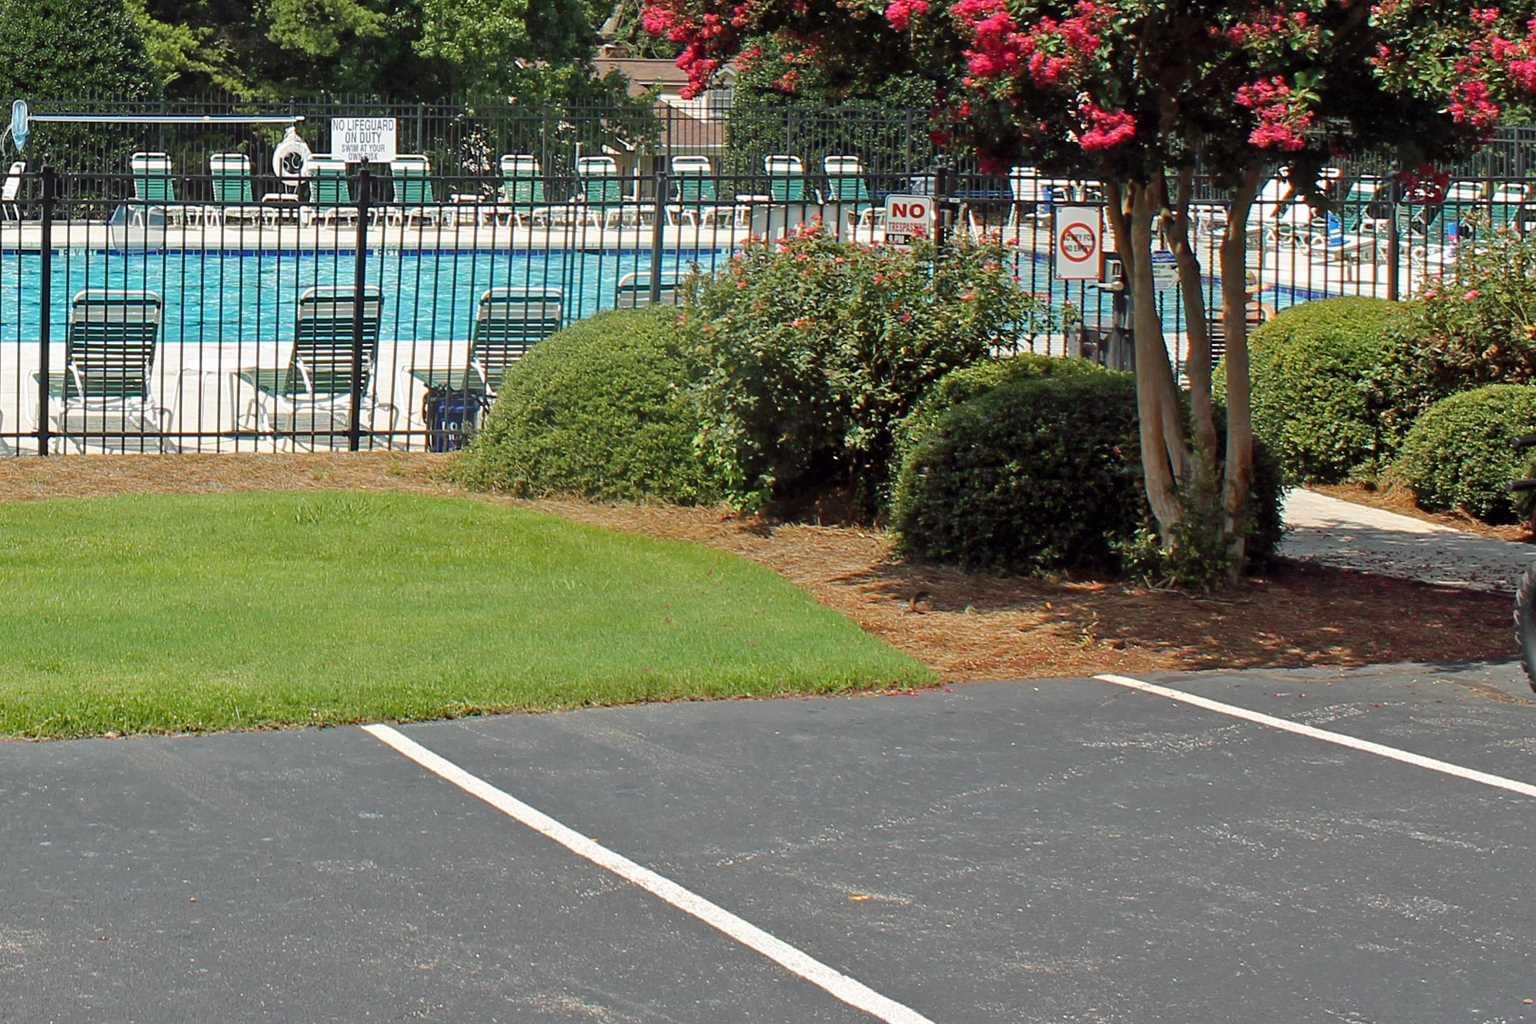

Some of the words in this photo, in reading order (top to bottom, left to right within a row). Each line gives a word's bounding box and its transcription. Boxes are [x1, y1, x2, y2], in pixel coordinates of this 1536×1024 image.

[332, 119, 345, 131] NO
[347, 119, 394, 131] LIFEGUARD
[345, 132, 358, 143] ON
[359, 132, 382, 143] DUTY
[341, 144, 359, 152] SWIM
[360, 144, 368, 152] AT
[369, 144, 386, 152] YOUR
[892, 203, 925, 218] NO
[888, 221, 928, 233] TRESPAS
